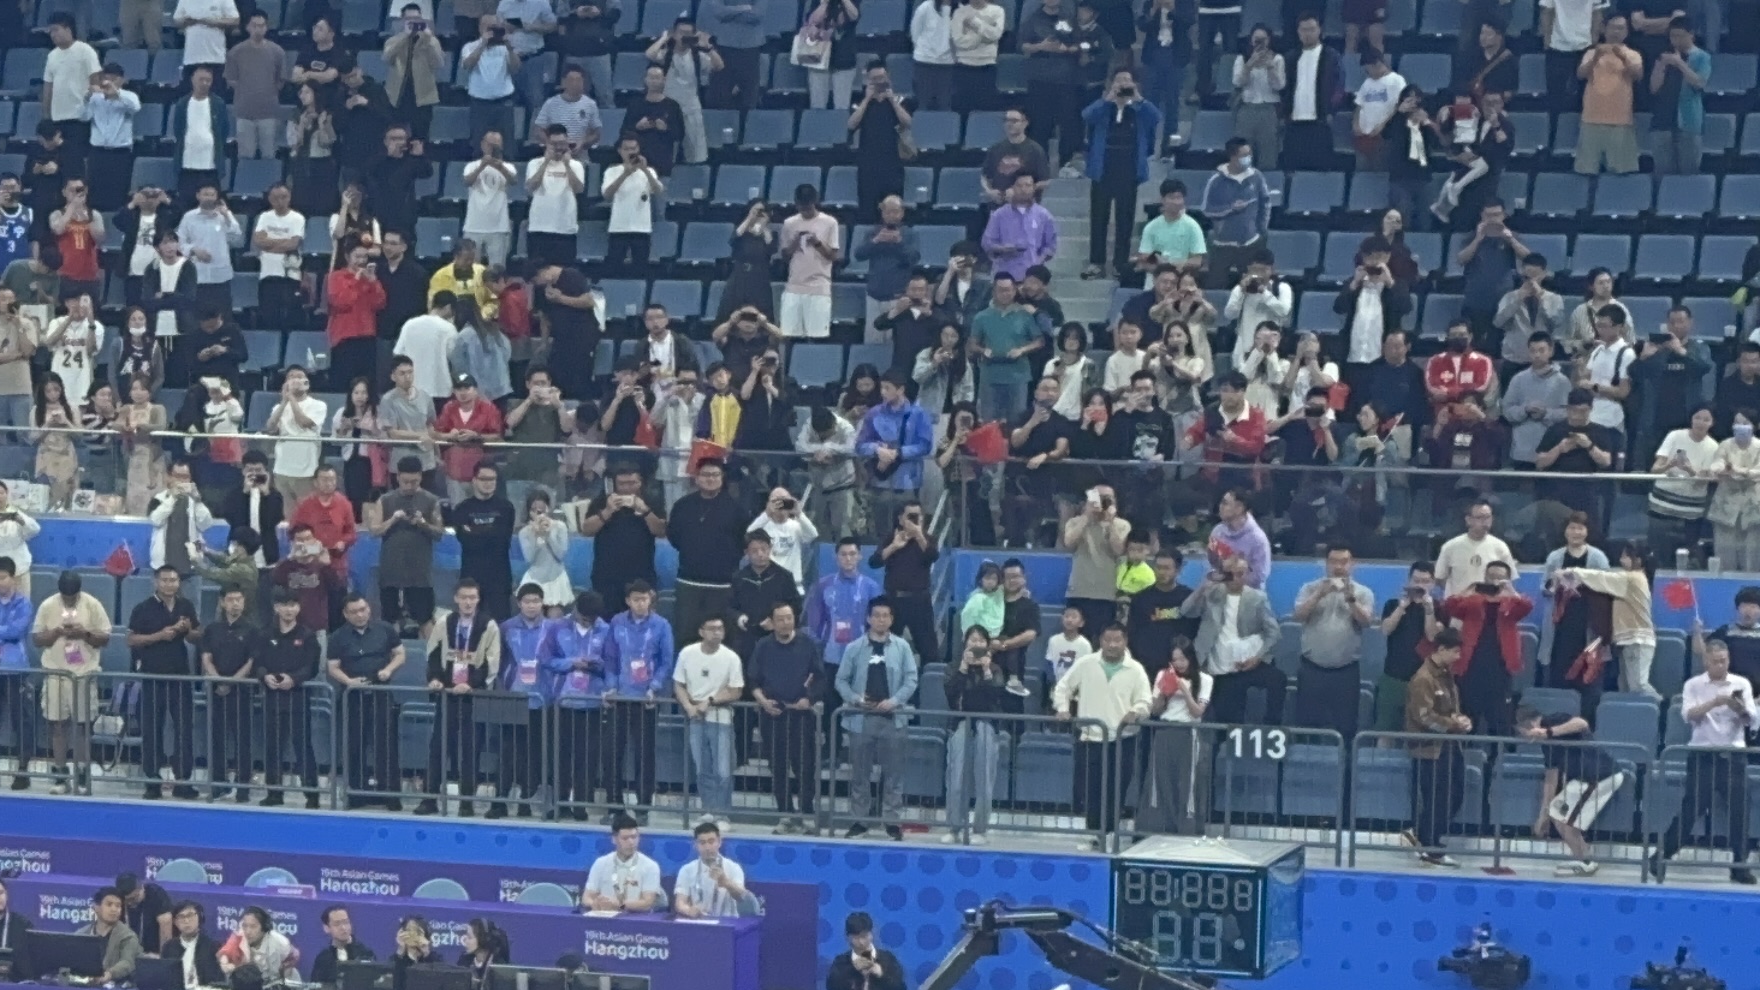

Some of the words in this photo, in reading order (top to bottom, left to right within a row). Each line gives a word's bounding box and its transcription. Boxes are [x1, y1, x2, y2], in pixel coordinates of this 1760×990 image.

[62, 350, 84, 369] 24
[1229, 727, 1287, 760] 113
[320, 867, 341, 878] 19th
[343, 869, 369, 880] Asian
[371, 871, 400, 882] Games
[320, 879, 400, 897] Hangzhou
[40, 907, 97, 924] Hangzh
[636, 934, 669, 946] Games
[584, 942, 669, 961] Hangzhou
